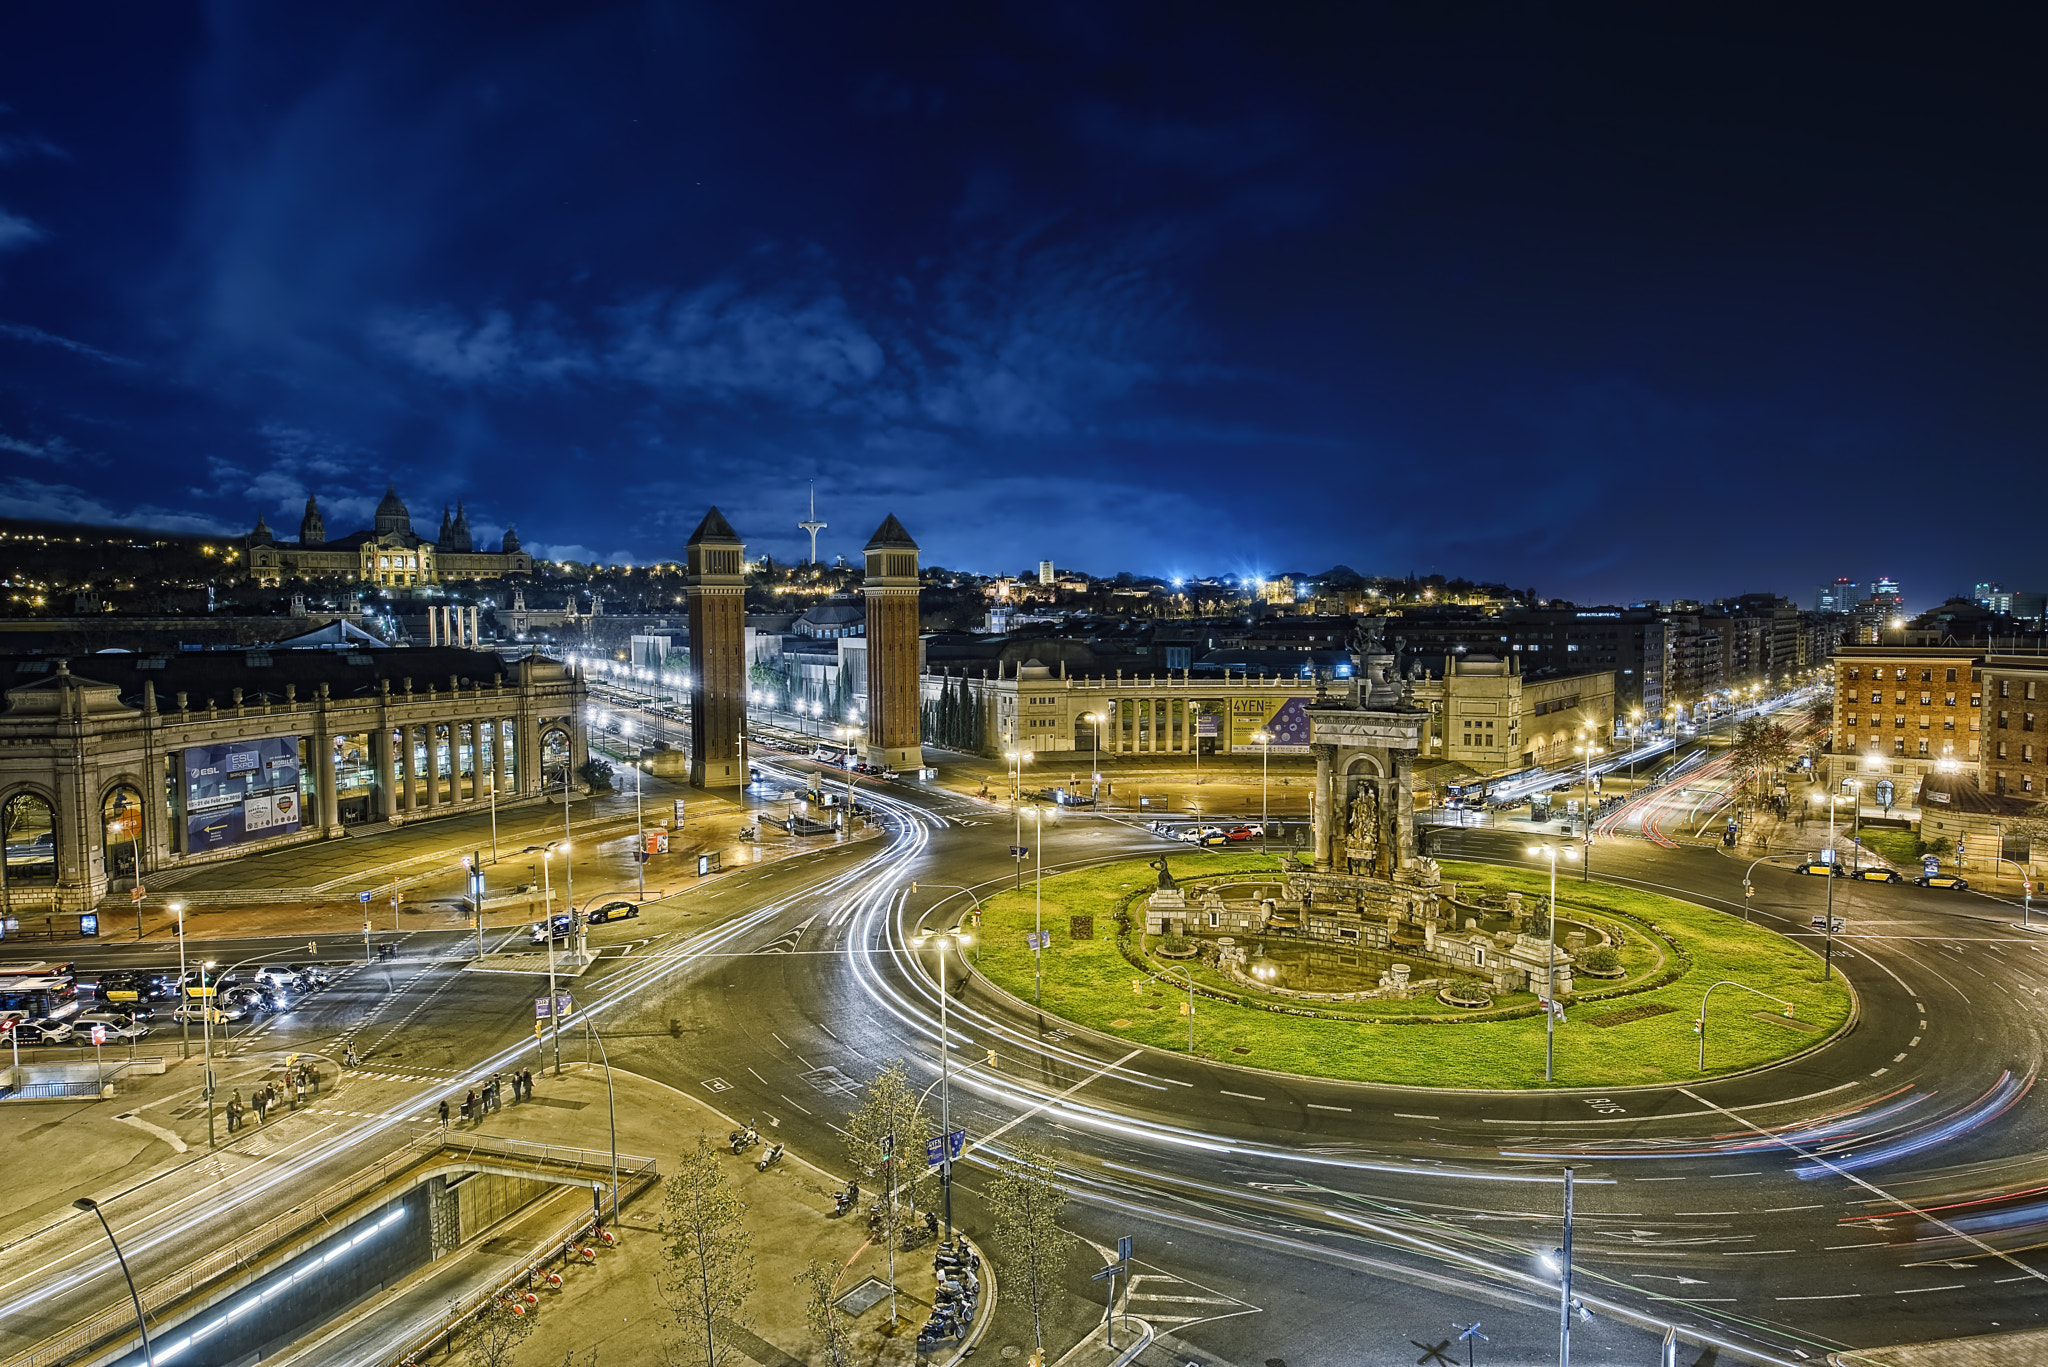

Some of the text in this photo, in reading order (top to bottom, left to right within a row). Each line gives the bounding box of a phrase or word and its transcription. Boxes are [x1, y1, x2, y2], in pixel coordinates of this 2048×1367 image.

[1233, 700, 1264, 712] 4YFN
[232, 753, 254, 764] ESL
[232, 761, 254, 770] EXPO
[200, 767, 220, 776] ESL
[123, 820, 138, 828] Fira
[1041, 1028, 1076, 1042] BUS
[1582, 1098, 1627, 1114] BUS
